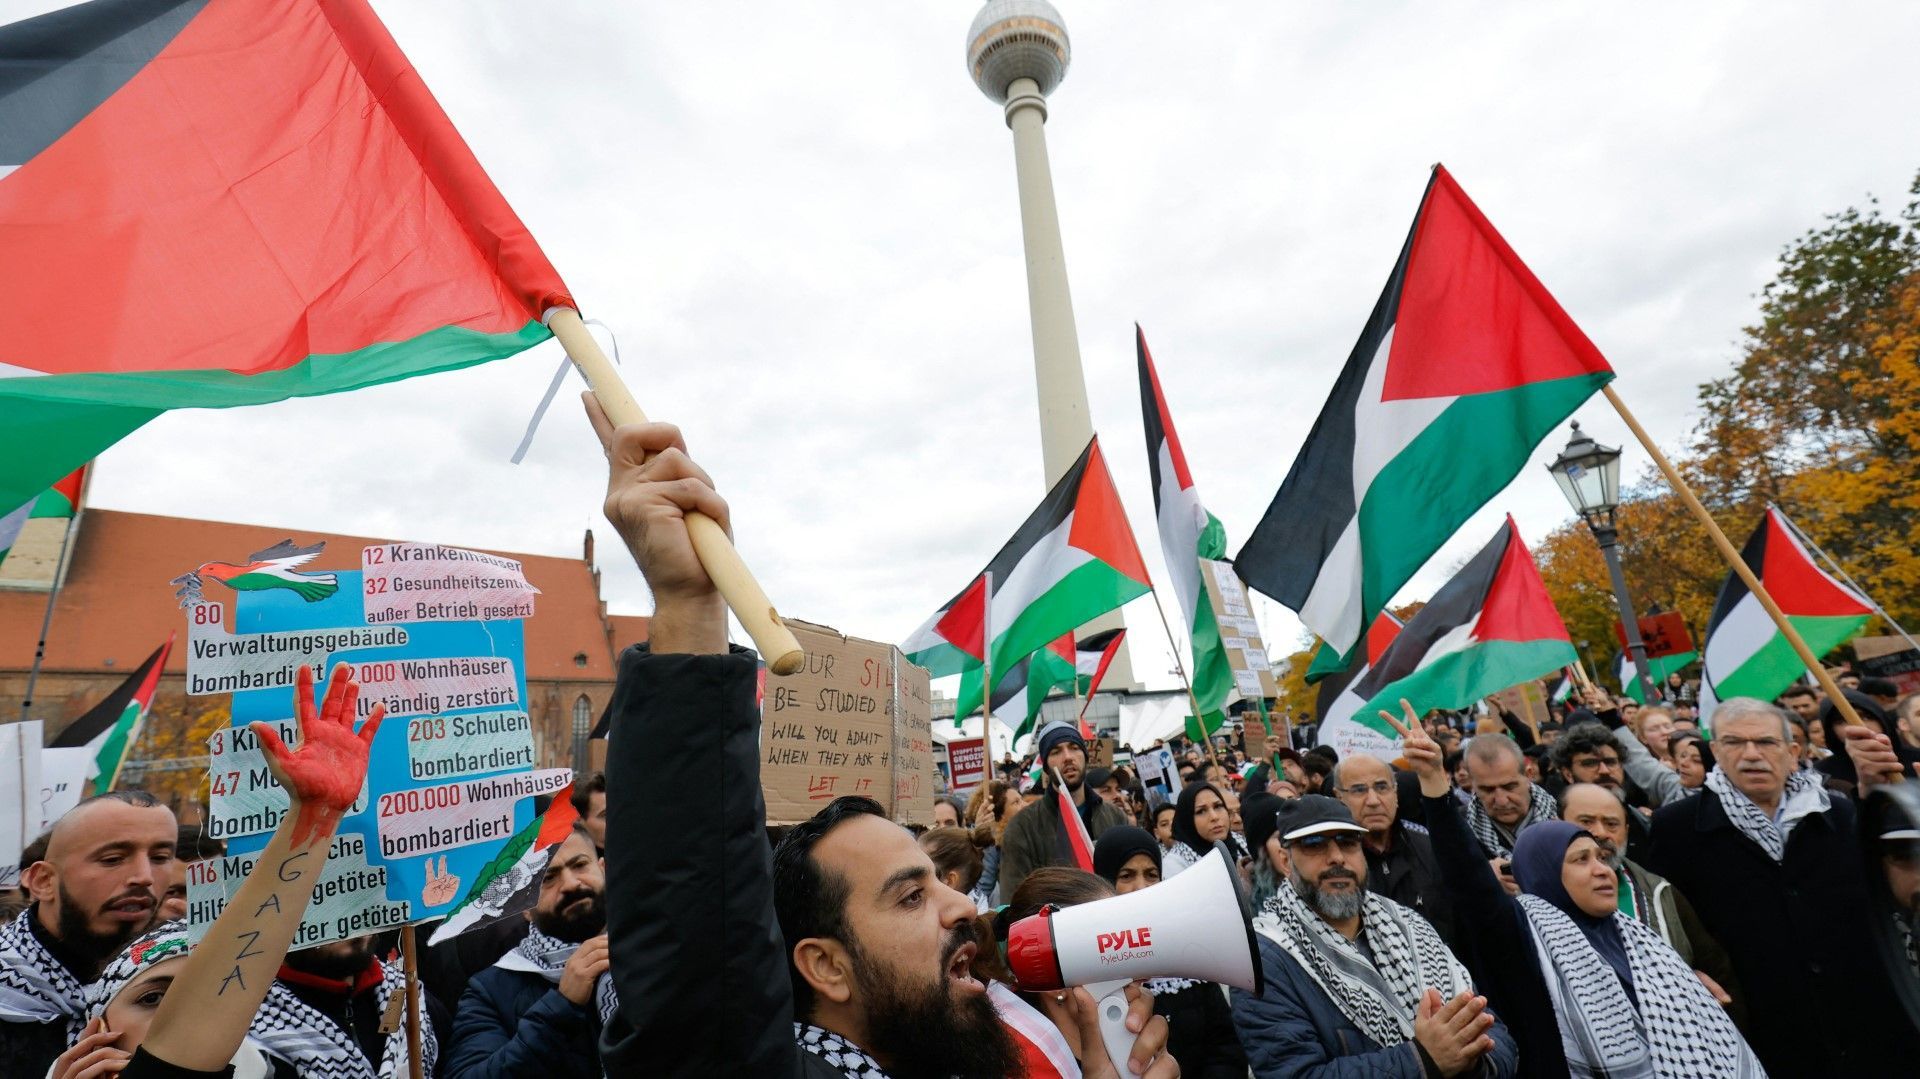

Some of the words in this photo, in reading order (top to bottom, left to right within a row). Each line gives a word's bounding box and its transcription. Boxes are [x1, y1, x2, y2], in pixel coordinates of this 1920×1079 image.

[364, 547, 384, 565] 12
[391, 545, 521, 572] Krankenhäuser
[366, 577, 387, 595] 32
[194, 604, 221, 625] 80
[367, 607, 410, 623] außer
[416, 601, 478, 619] Betrieb
[483, 603, 532, 621] gesetzt
[194, 628, 407, 659] Verwaltungsgebäude
[401, 659, 508, 681] Wohnhäuser
[795, 651, 835, 679] OUR
[192, 663, 323, 694] bombardit
[446, 686, 514, 708] zerstört
[774, 686, 801, 712] BE
[816, 687, 876, 713] STUDIED
[409, 718, 446, 742] 203
[452, 713, 528, 738] Schulen
[771, 721, 806, 740] WILL
[814, 725, 838, 746] YOU
[846, 729, 883, 746] ADMIT
[211, 732, 224, 756] 3
[768, 746, 809, 765] WHEN
[818, 750, 849, 766] THEY
[854, 752, 874, 767] ASK
[411, 745, 532, 778] bombardiert
[211, 771, 240, 796] 47
[381, 785, 460, 818] 200.000
[466, 770, 571, 803] Wohnhäuser
[808, 775, 840, 793] LET
[855, 778, 873, 792] IT
[382, 814, 510, 857] bombardiert
[188, 861, 217, 886] 116
[312, 867, 386, 906] getötet
[337, 901, 409, 939] getötet
[1097, 927, 1152, 953] PYLE
[1100, 950, 1154, 965] PyleUSA.com
